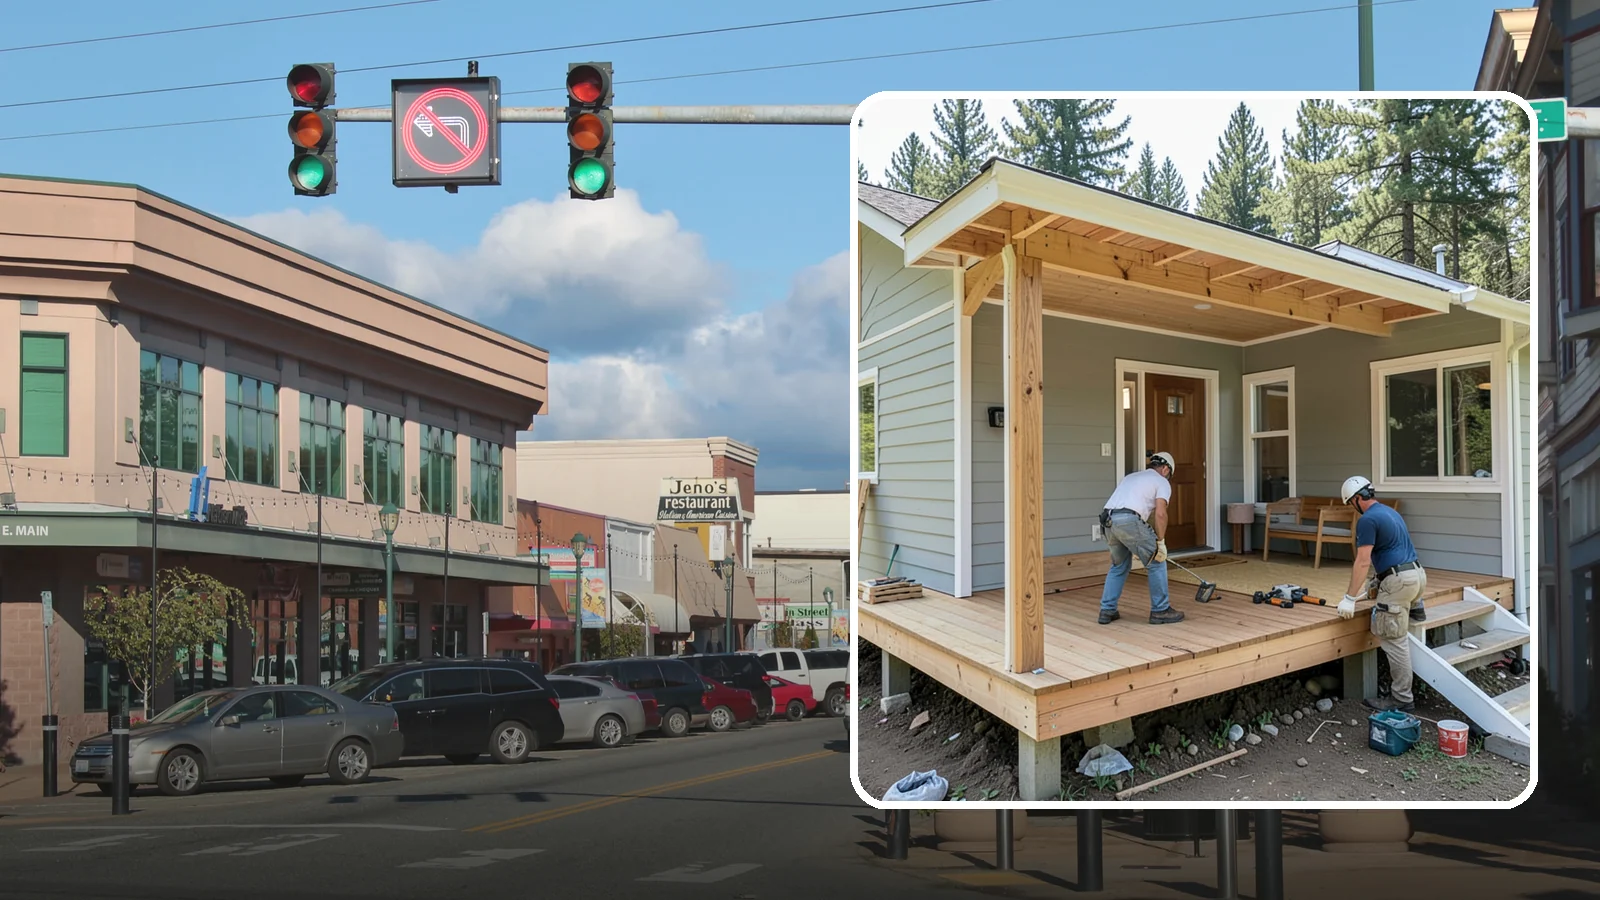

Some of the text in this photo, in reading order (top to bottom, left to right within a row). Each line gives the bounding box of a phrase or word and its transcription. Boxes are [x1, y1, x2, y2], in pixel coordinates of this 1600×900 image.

[669, 480, 727, 494] Jeno's
[665, 496, 731, 509] restaurant
[659, 510, 681, 519] Italian
[686, 510, 714, 519] American
[715, 510, 737, 519] Cuisine
[2, 525, 49, 537] E. MAIN
[798, 608, 828, 616] Street
